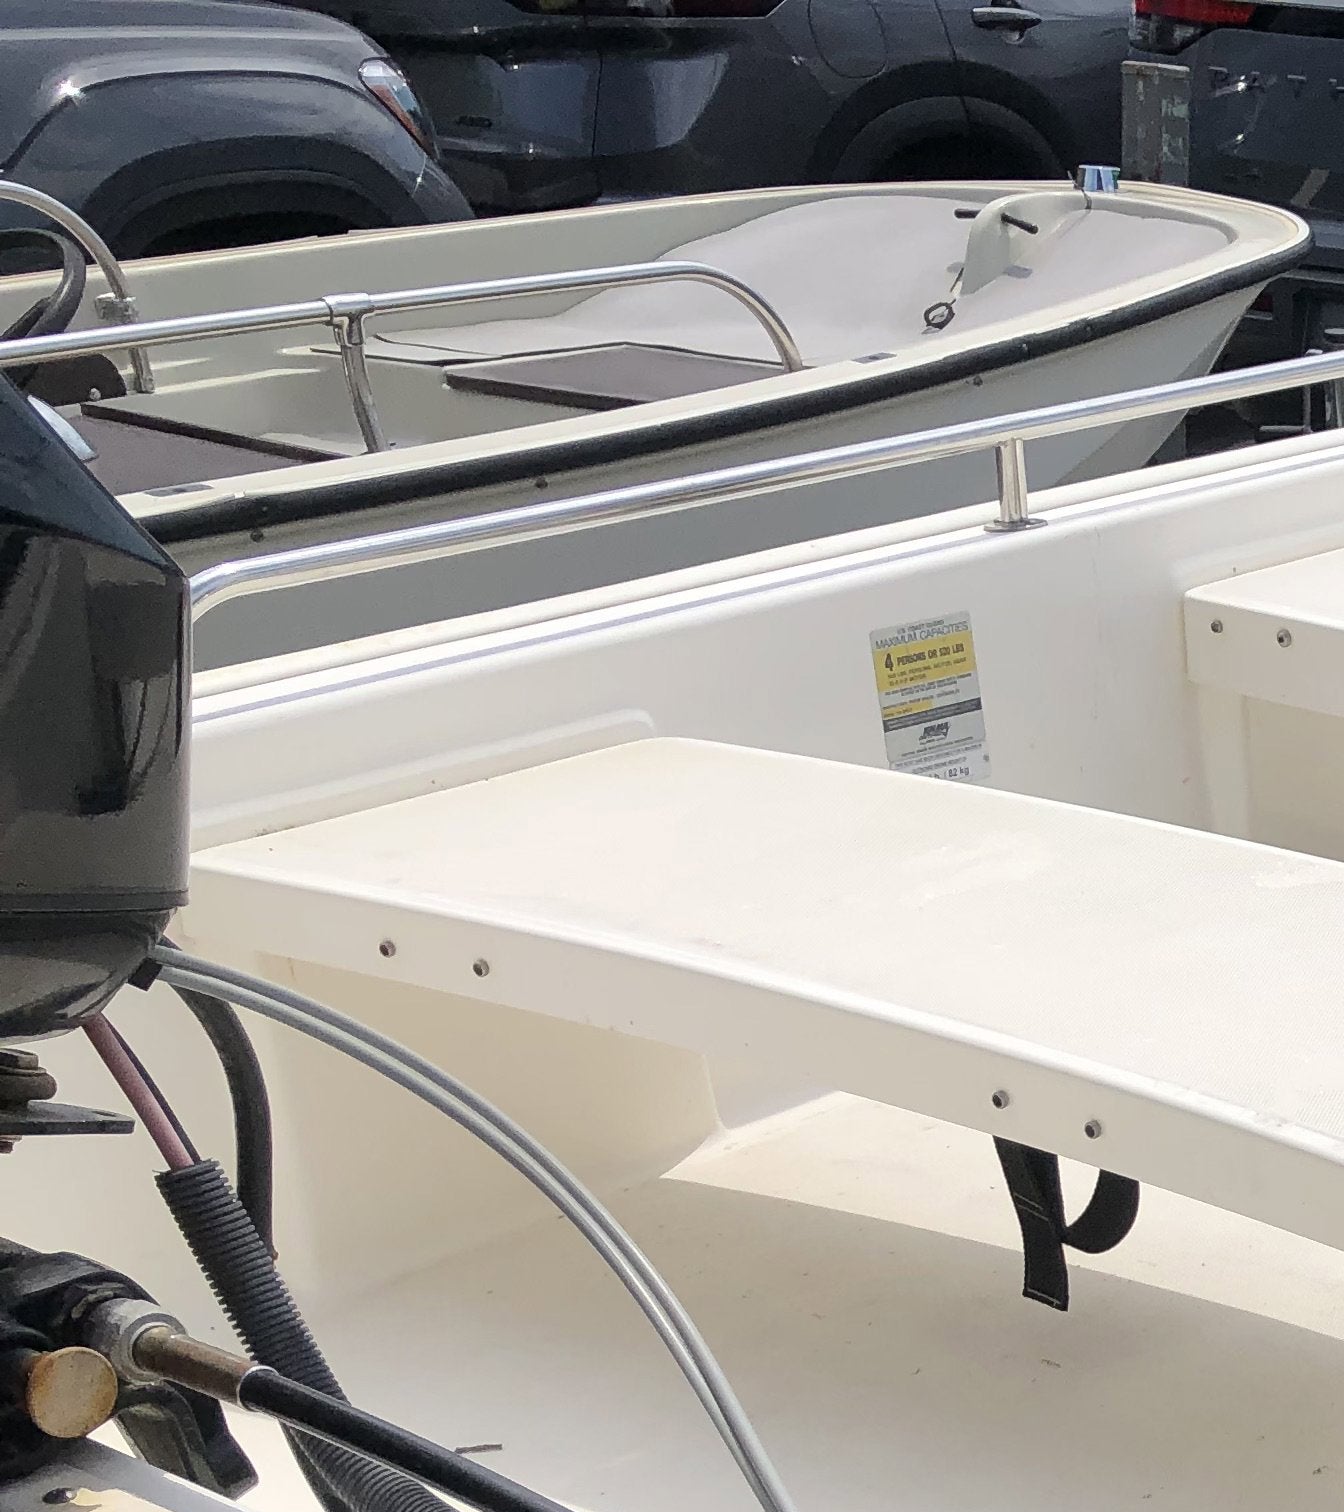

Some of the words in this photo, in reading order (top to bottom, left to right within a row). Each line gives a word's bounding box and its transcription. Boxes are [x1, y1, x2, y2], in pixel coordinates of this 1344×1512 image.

[875, 632, 917, 649] MAXIMUM
[919, 620, 969, 641] CAPACITIES
[884, 653, 894, 671] 4
[896, 651, 927, 666] PERSONS
[959, 766, 970, 776] kg
